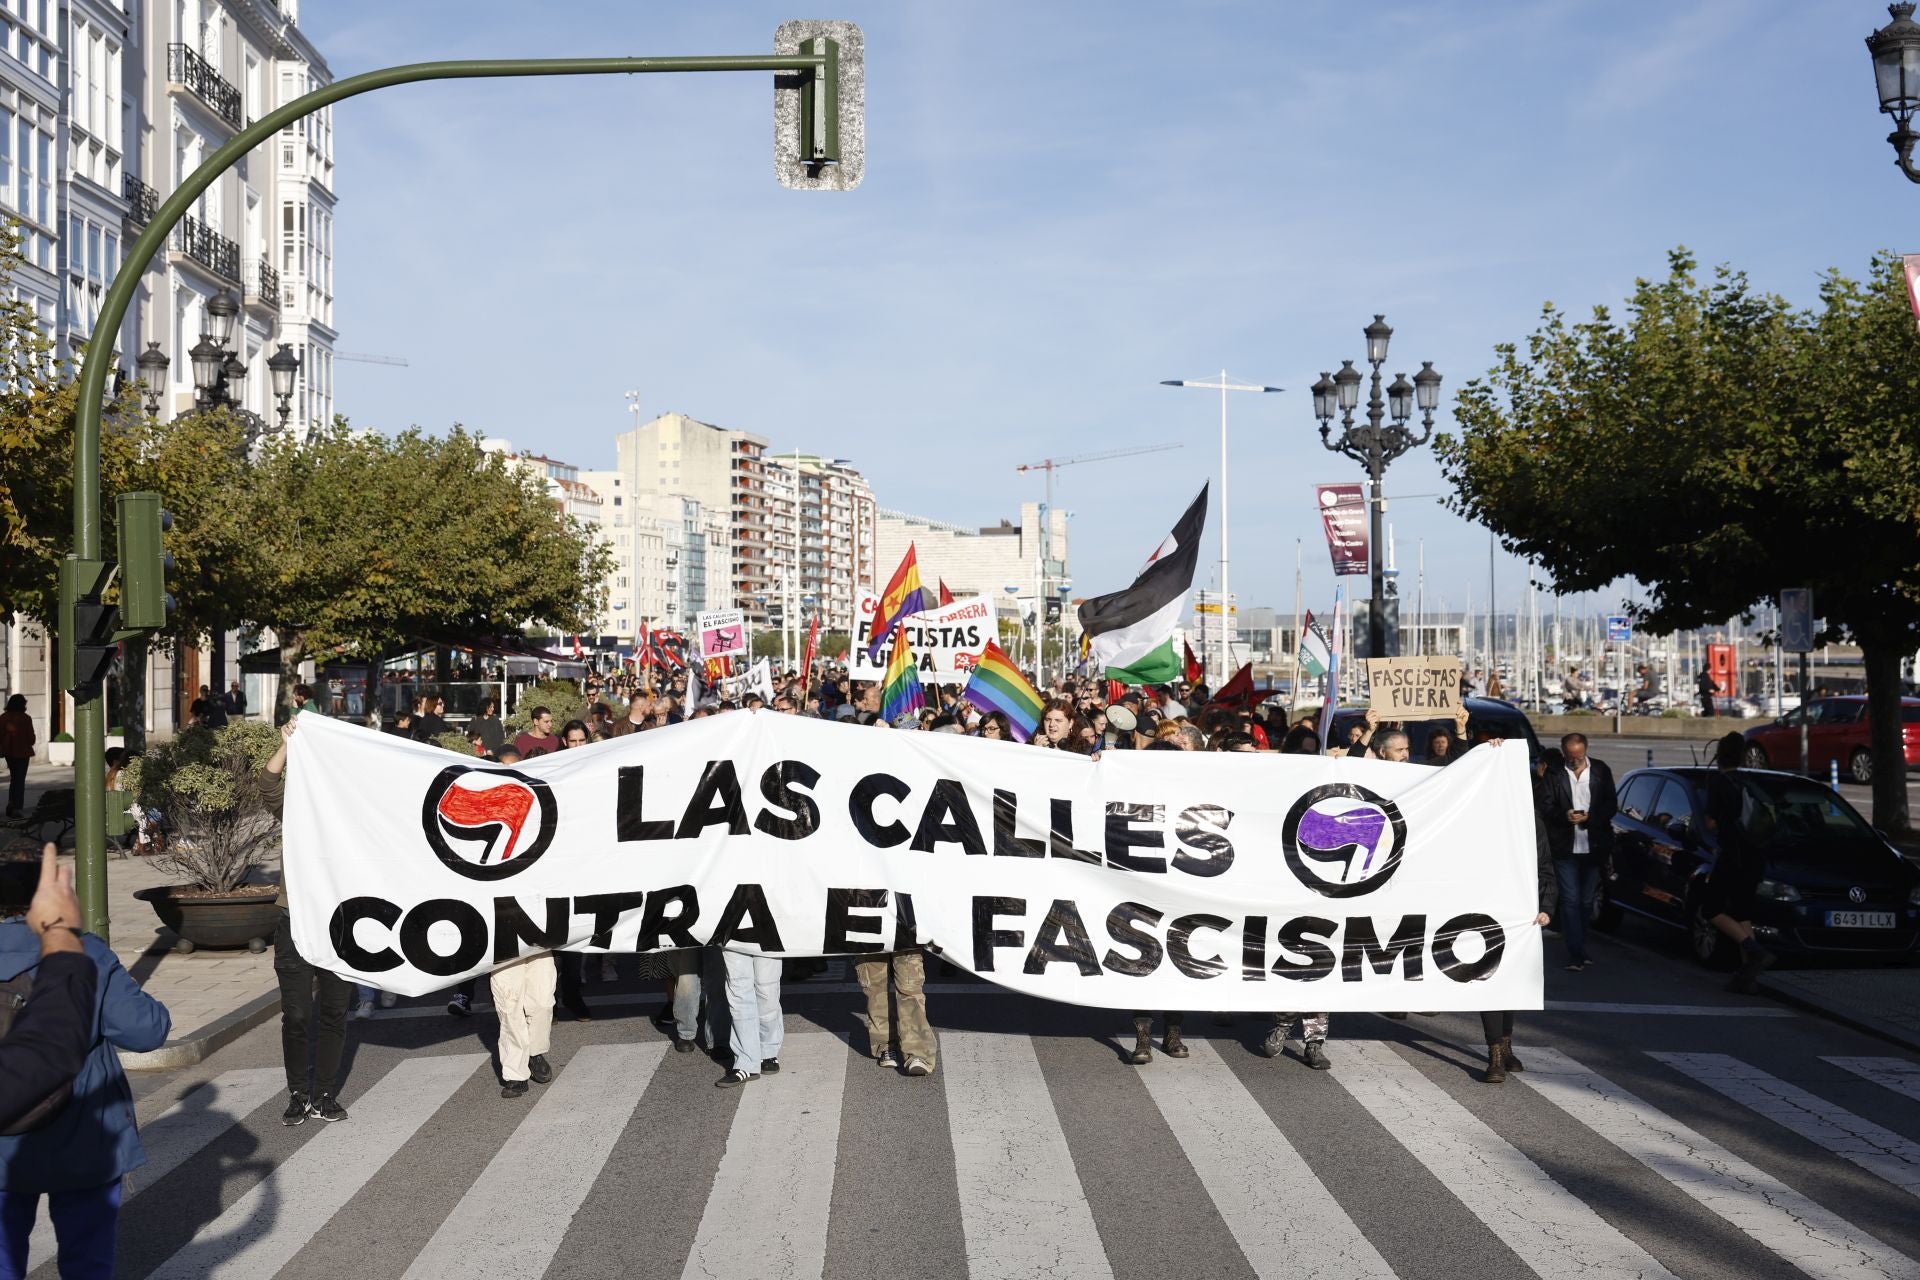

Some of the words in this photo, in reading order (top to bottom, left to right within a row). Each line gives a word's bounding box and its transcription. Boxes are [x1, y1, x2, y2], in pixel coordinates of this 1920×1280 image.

[713, 617, 739, 627] FASCISMO
[858, 621, 980, 648] FSCISTAS
[856, 647, 938, 672] FUA
[1392, 686, 1450, 708] FUERA
[617, 760, 821, 842] LAS
[849, 773, 1235, 877] CALLES
[1833, 912, 1865, 926] 6431
[1869, 914, 1892, 926] LLX
[329, 884, 785, 976] CONTRA
[971, 895, 1506, 983] FASCISMO
